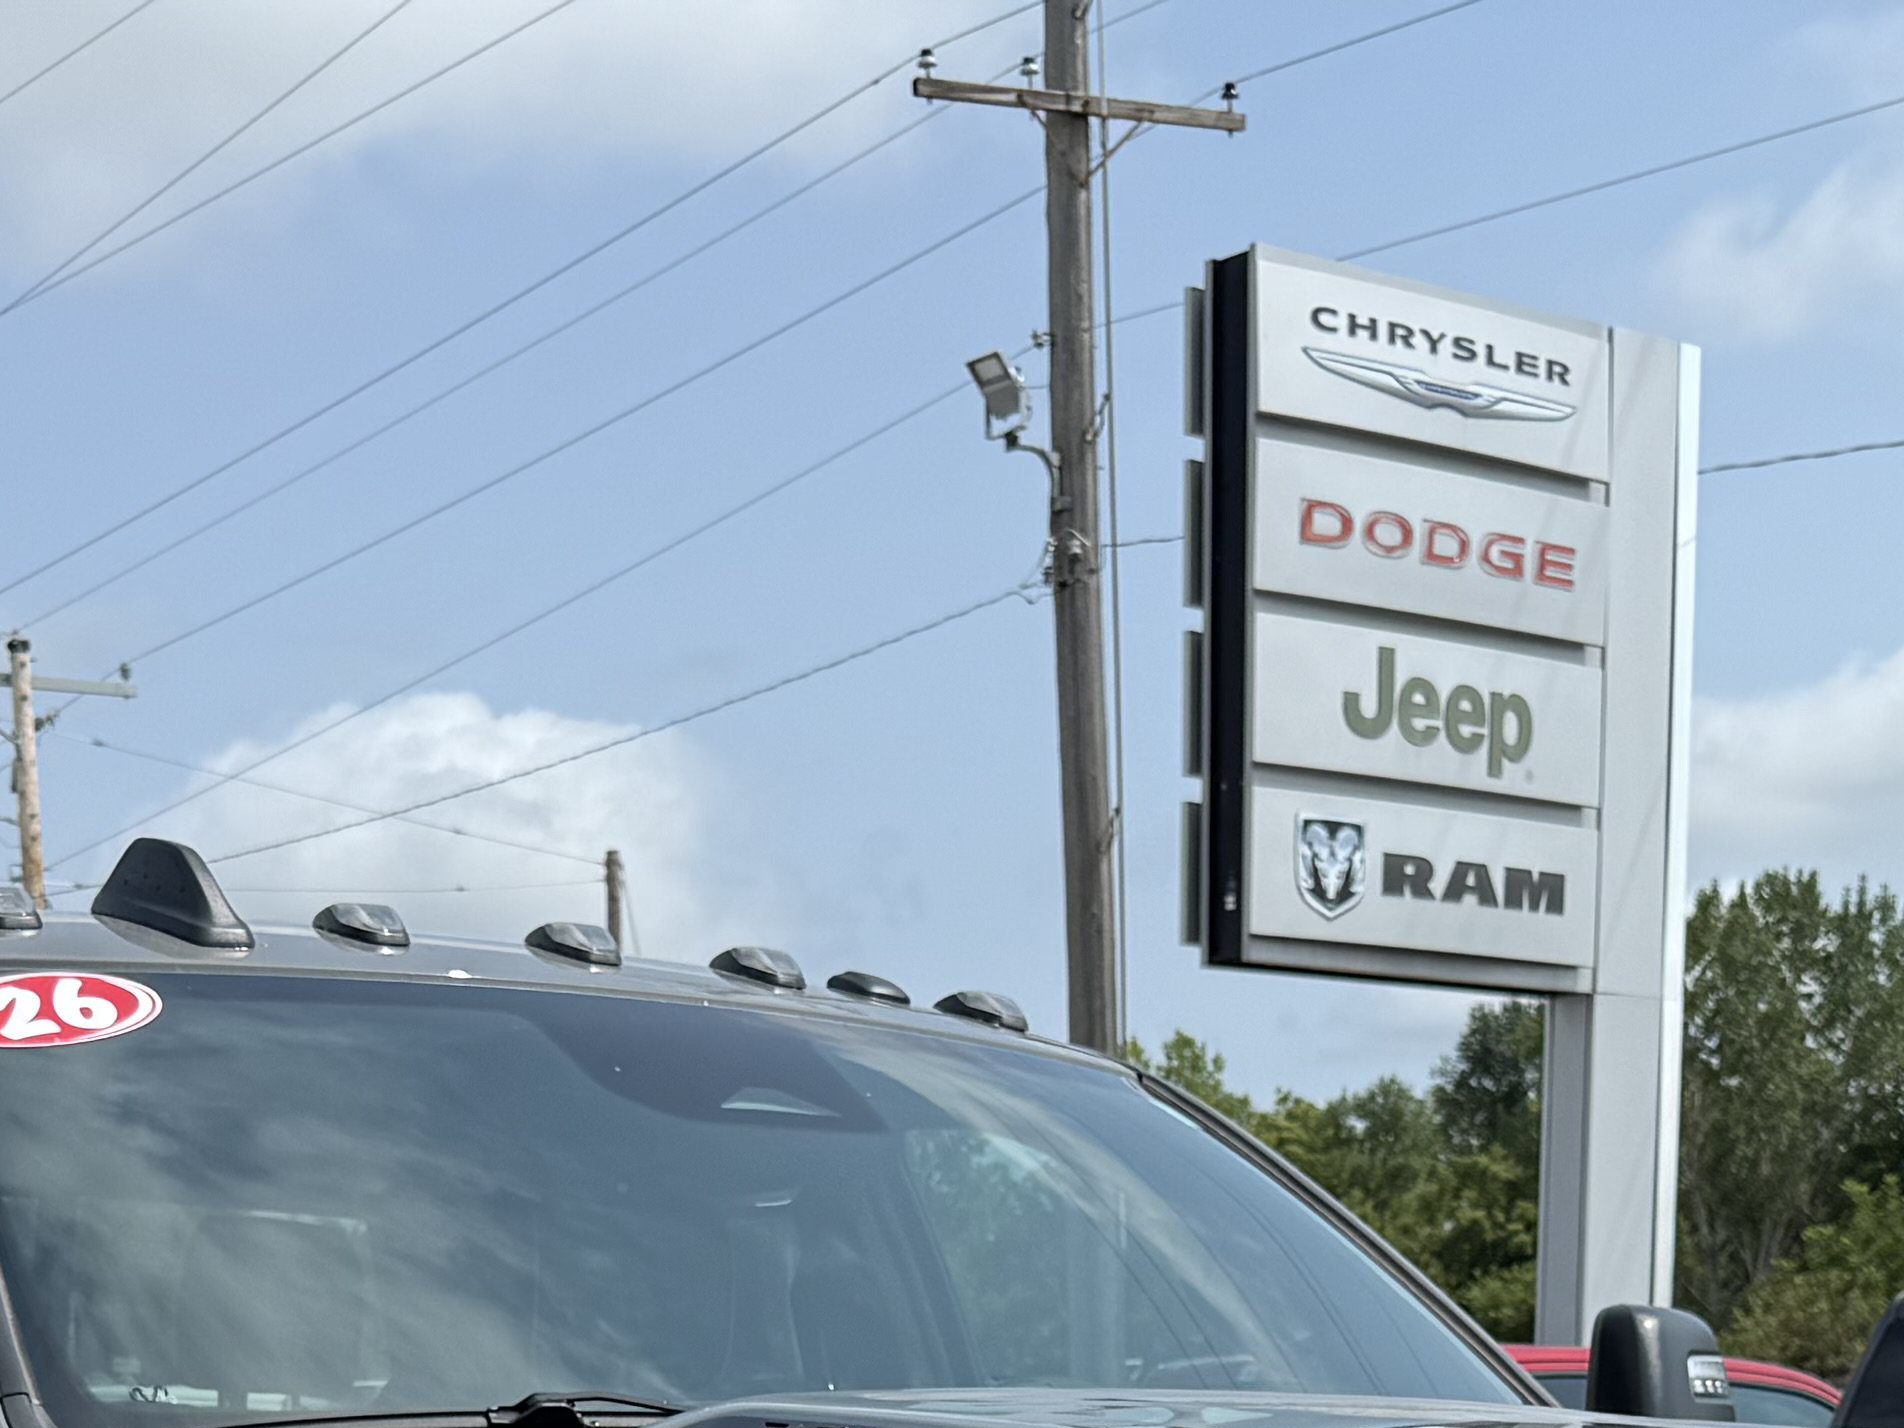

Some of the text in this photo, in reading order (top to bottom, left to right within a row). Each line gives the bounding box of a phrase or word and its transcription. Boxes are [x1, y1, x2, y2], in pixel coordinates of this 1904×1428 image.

[1309, 305, 1572, 388] CHRYSLER
[1300, 498, 1576, 590] DODGE
[1342, 646, 1533, 778] Jeep
[1381, 852, 1565, 916] RAM
